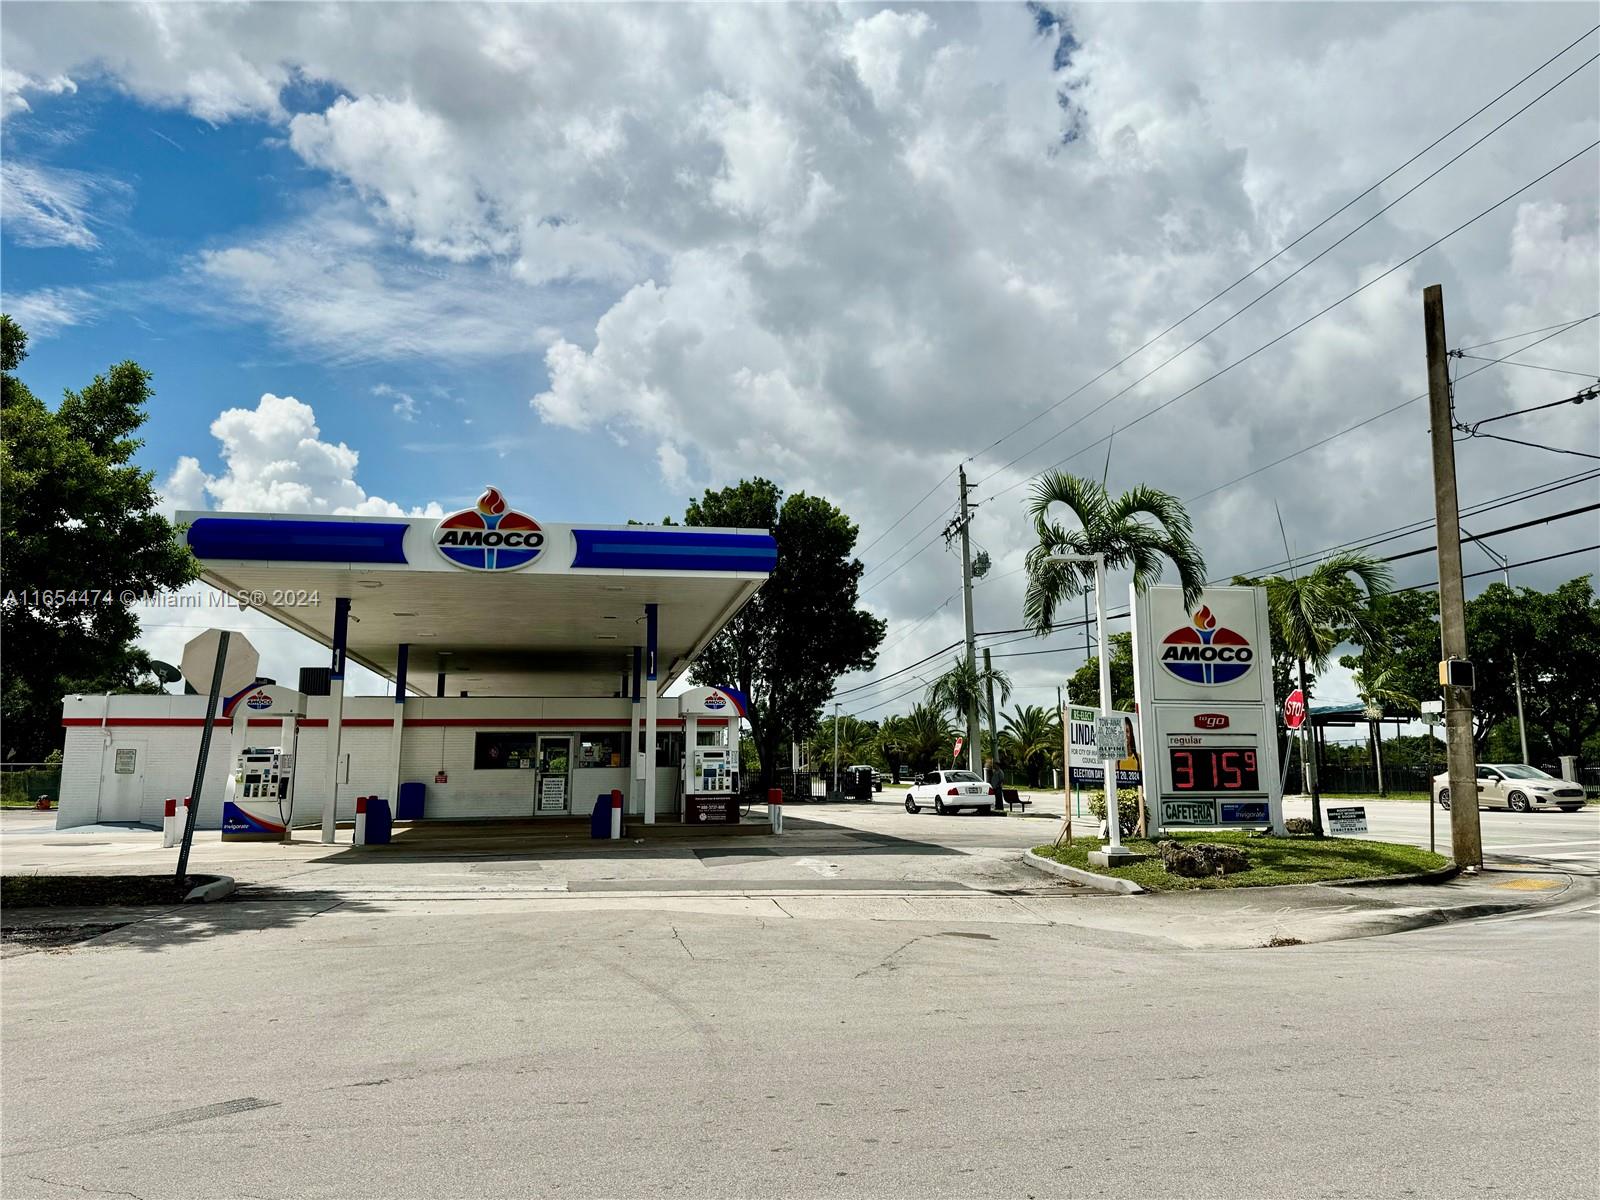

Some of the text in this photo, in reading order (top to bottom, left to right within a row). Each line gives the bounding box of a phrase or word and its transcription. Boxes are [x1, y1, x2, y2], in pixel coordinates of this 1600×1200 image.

[438, 530, 544, 547] AMOCO
[1161, 646, 1253, 662] AMOCO
[1207, 716, 1225, 727] go
[1071, 723, 1096, 746] LINDA
[1169, 736, 1202, 745] regular
[1073, 769, 1095, 778] ELECTION
[1128, 772, 1140, 780] 2024
[1166, 804, 1212, 820] CAFETERIA
